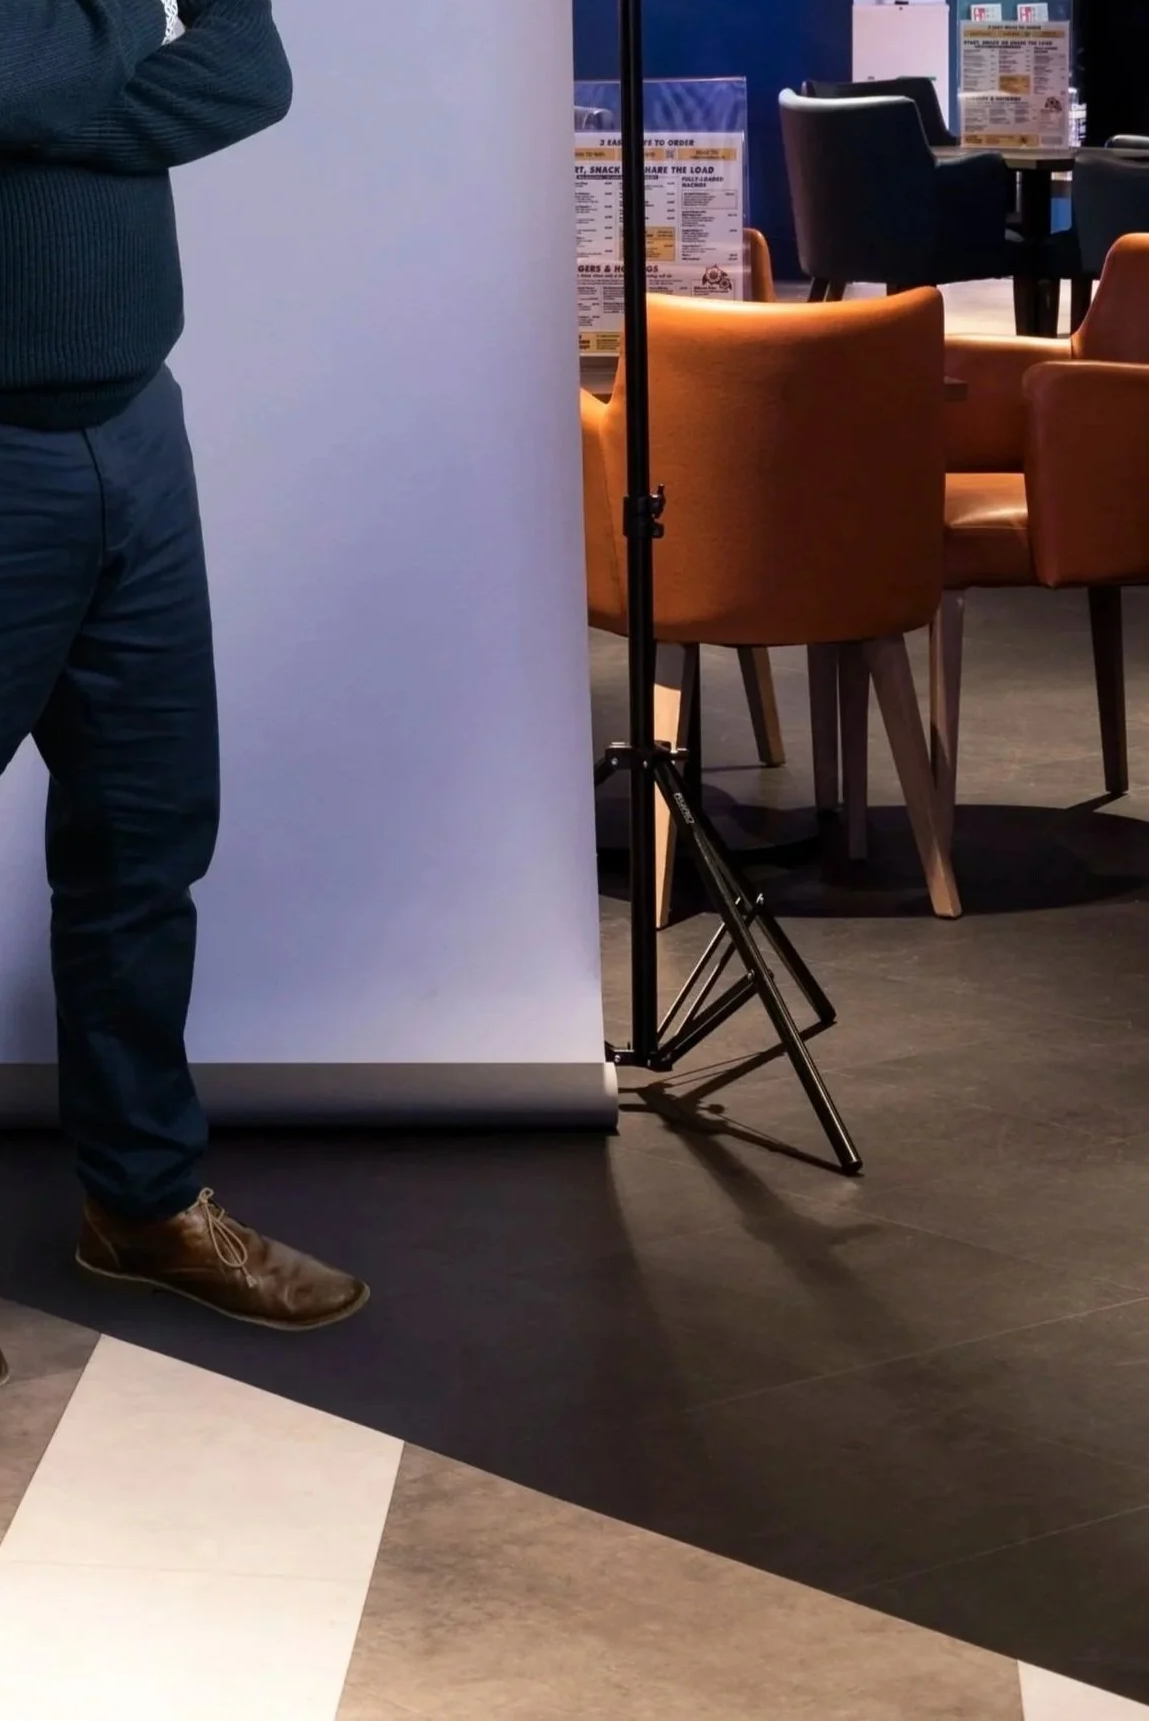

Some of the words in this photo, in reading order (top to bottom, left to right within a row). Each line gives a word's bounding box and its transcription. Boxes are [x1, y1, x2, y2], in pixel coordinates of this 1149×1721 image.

[607, 139, 623, 147] EAS
[655, 139, 666, 147] TO
[667, 139, 695, 147] ORDER
[590, 166, 621, 174] SNACK
[645, 166, 668, 174] HARE
[671, 166, 687, 174] THE
[690, 166, 715, 174] LOAD
[578, 265, 602, 273] GERS
[604, 265, 612, 273] &
